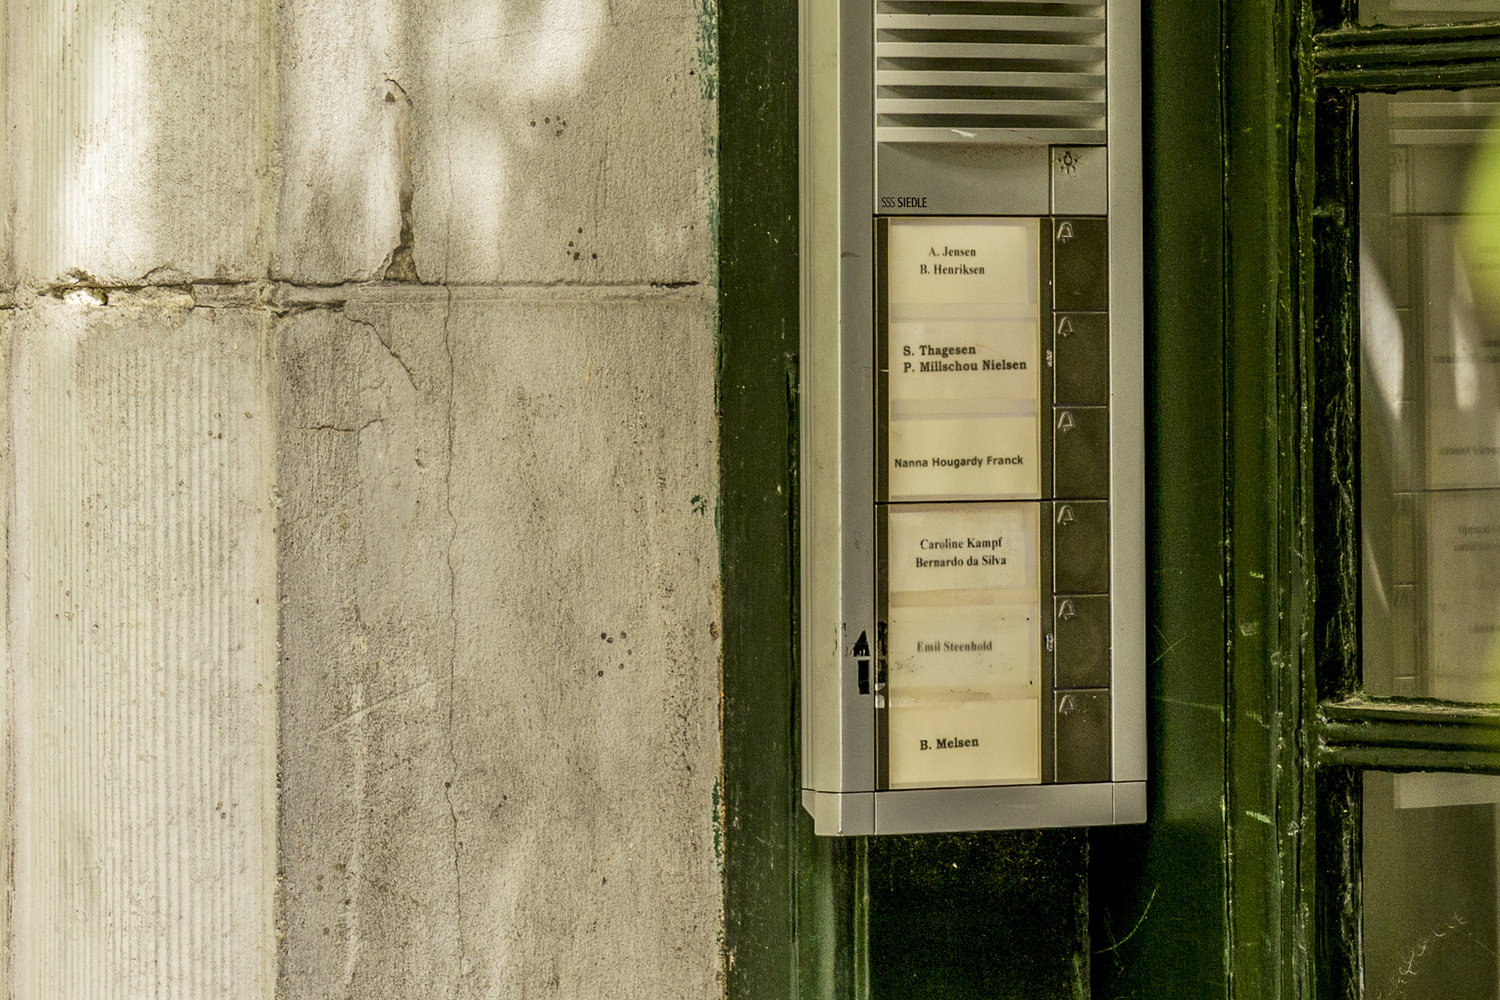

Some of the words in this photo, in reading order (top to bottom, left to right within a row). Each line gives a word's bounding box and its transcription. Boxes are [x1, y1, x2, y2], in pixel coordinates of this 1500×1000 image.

[897, 196, 928, 208] SIEDLE
[928, 247, 940, 257] A.
[942, 246, 977, 258] Jensen
[919, 264, 931, 275] B.
[933, 263, 986, 275] Henriksen
[903, 345, 915, 356] S.
[919, 344, 977, 358] Thagesen
[903, 362, 915, 373] P.
[919, 361, 978, 373] Millschou
[981, 359, 1027, 371] Nielsen
[894, 458, 929, 468] Nanna
[932, 456, 984, 470] Hougardy
[986, 455, 1024, 466] Franck
[920, 538, 964, 550] Caroline
[966, 537, 1003, 551] Kampf
[915, 556, 964, 568] Bernardo
[966, 555, 979, 567] da
[981, 555, 1007, 567] Silva
[917, 641, 941, 652] Emil
[943, 640, 993, 652] Steenhold
[920, 739, 932, 750] B.
[936, 737, 979, 750] Melsen
